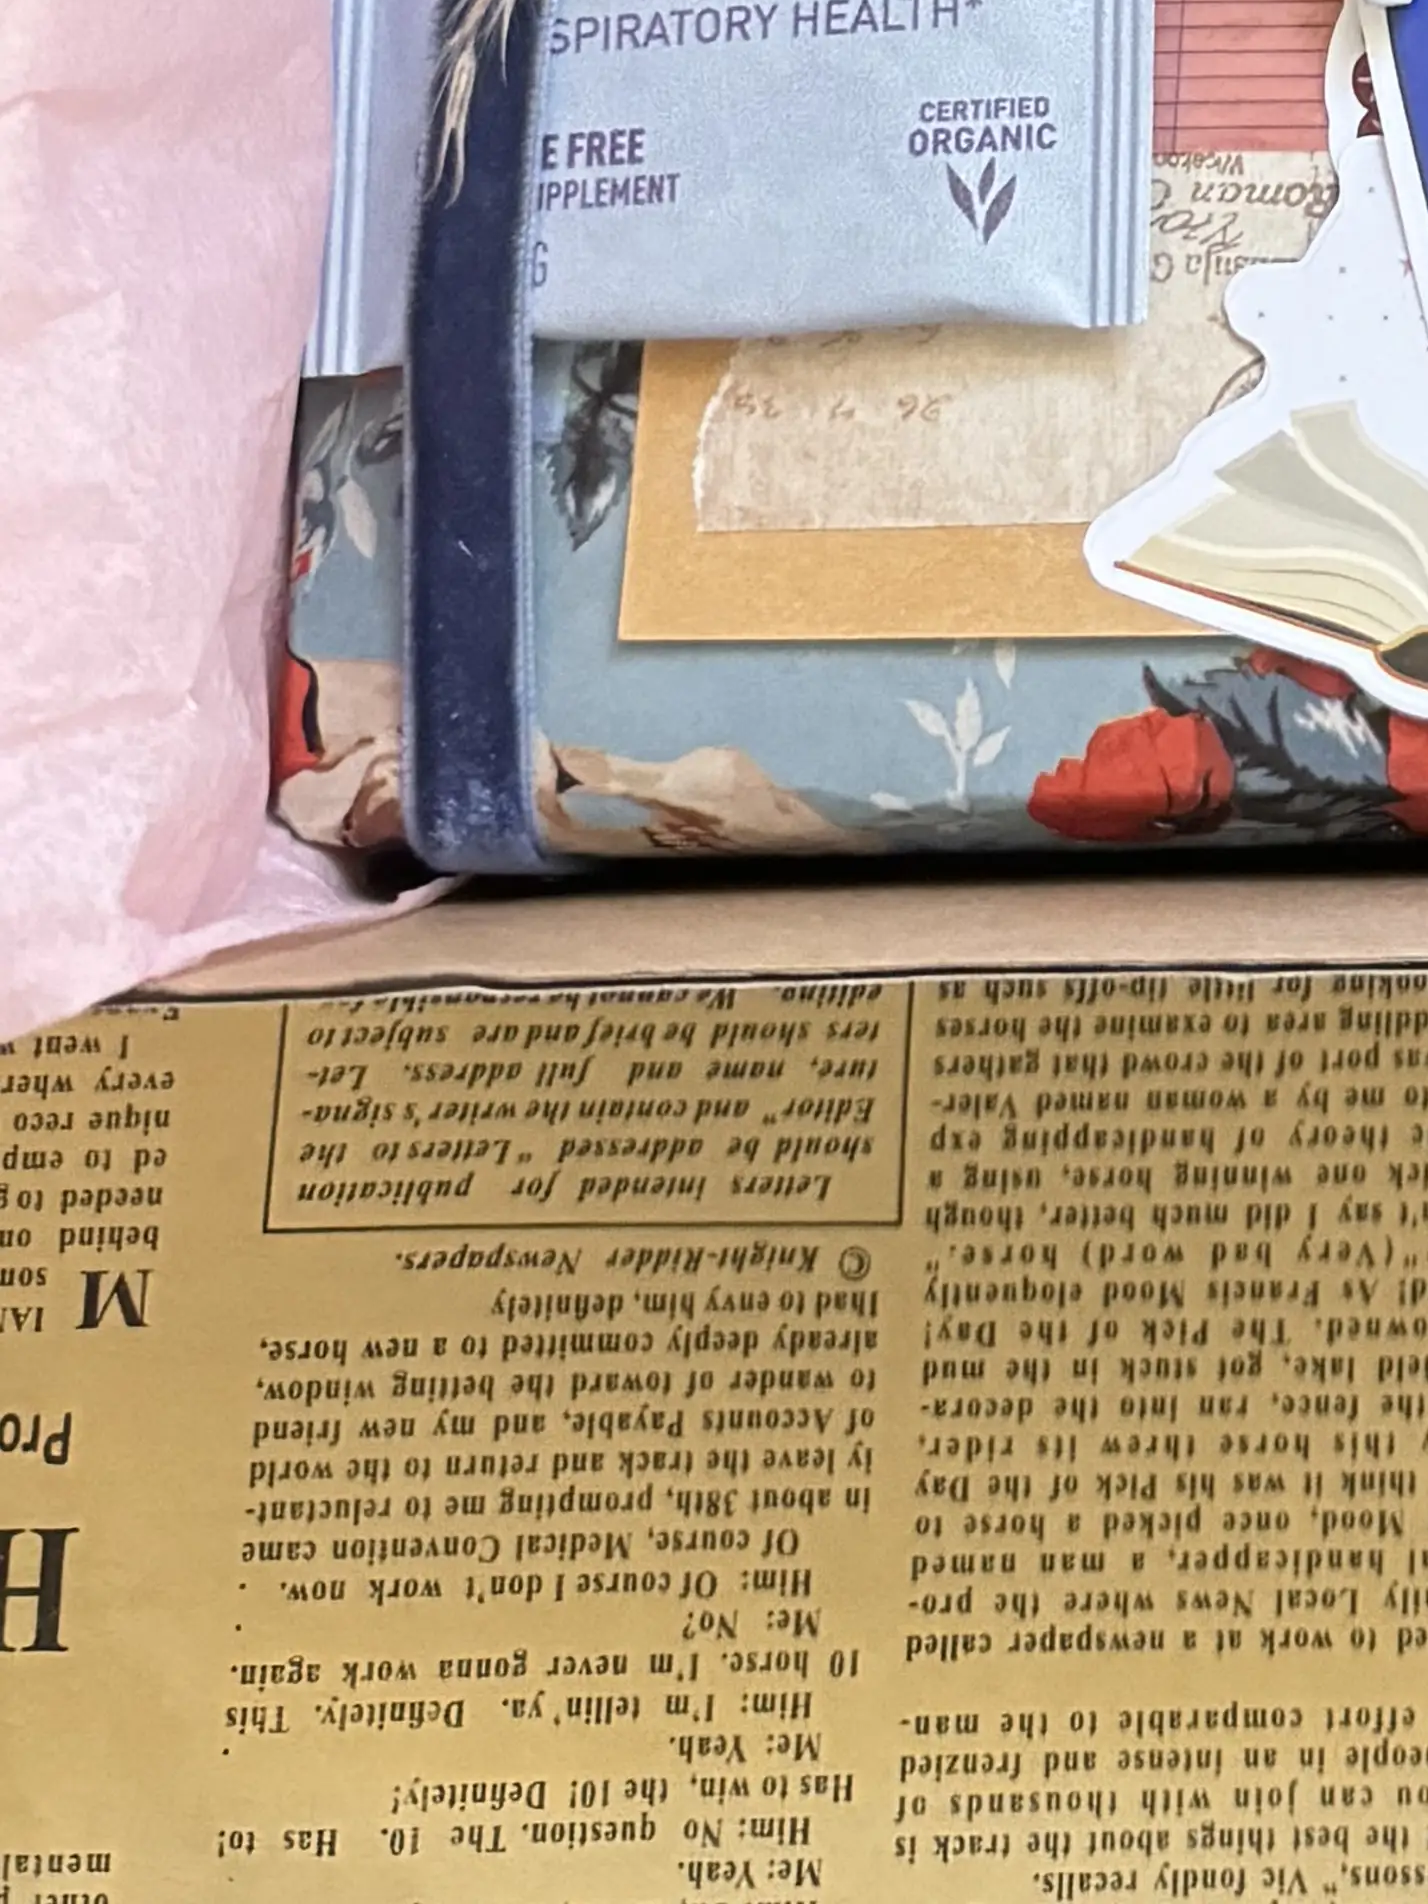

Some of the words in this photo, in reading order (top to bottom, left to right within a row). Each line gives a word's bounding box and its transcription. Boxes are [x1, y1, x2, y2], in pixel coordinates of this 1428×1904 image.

[549, 5, 777, 56] SPIRATORY
[919, 96, 1050, 122] CERTIFIED
[567, 127, 646, 167] FREE
[908, 123, 1057, 157] ORGANIC
[537, 172, 680, 211] PPLEMENT
[392, 1240, 583, 1278] Newspapers.
[603, 1238, 820, 1276] Knight-Ridder
[238, 1537, 318, 1564] came
[329, 1532, 501, 1568] Convention
[513, 1530, 633, 1564] Medical
[645, 1525, 751, 1554] course,
[759, 1526, 800, 1559] Of
[903, 1630, 994, 1664] called
[1005, 1621, 1166, 1655] newspaper
[1181, 1627, 1198, 1652] a
[1214, 1627, 1243, 1656] at
[1258, 1626, 1334, 1658] work
[1348, 1626, 1378, 1654] to
